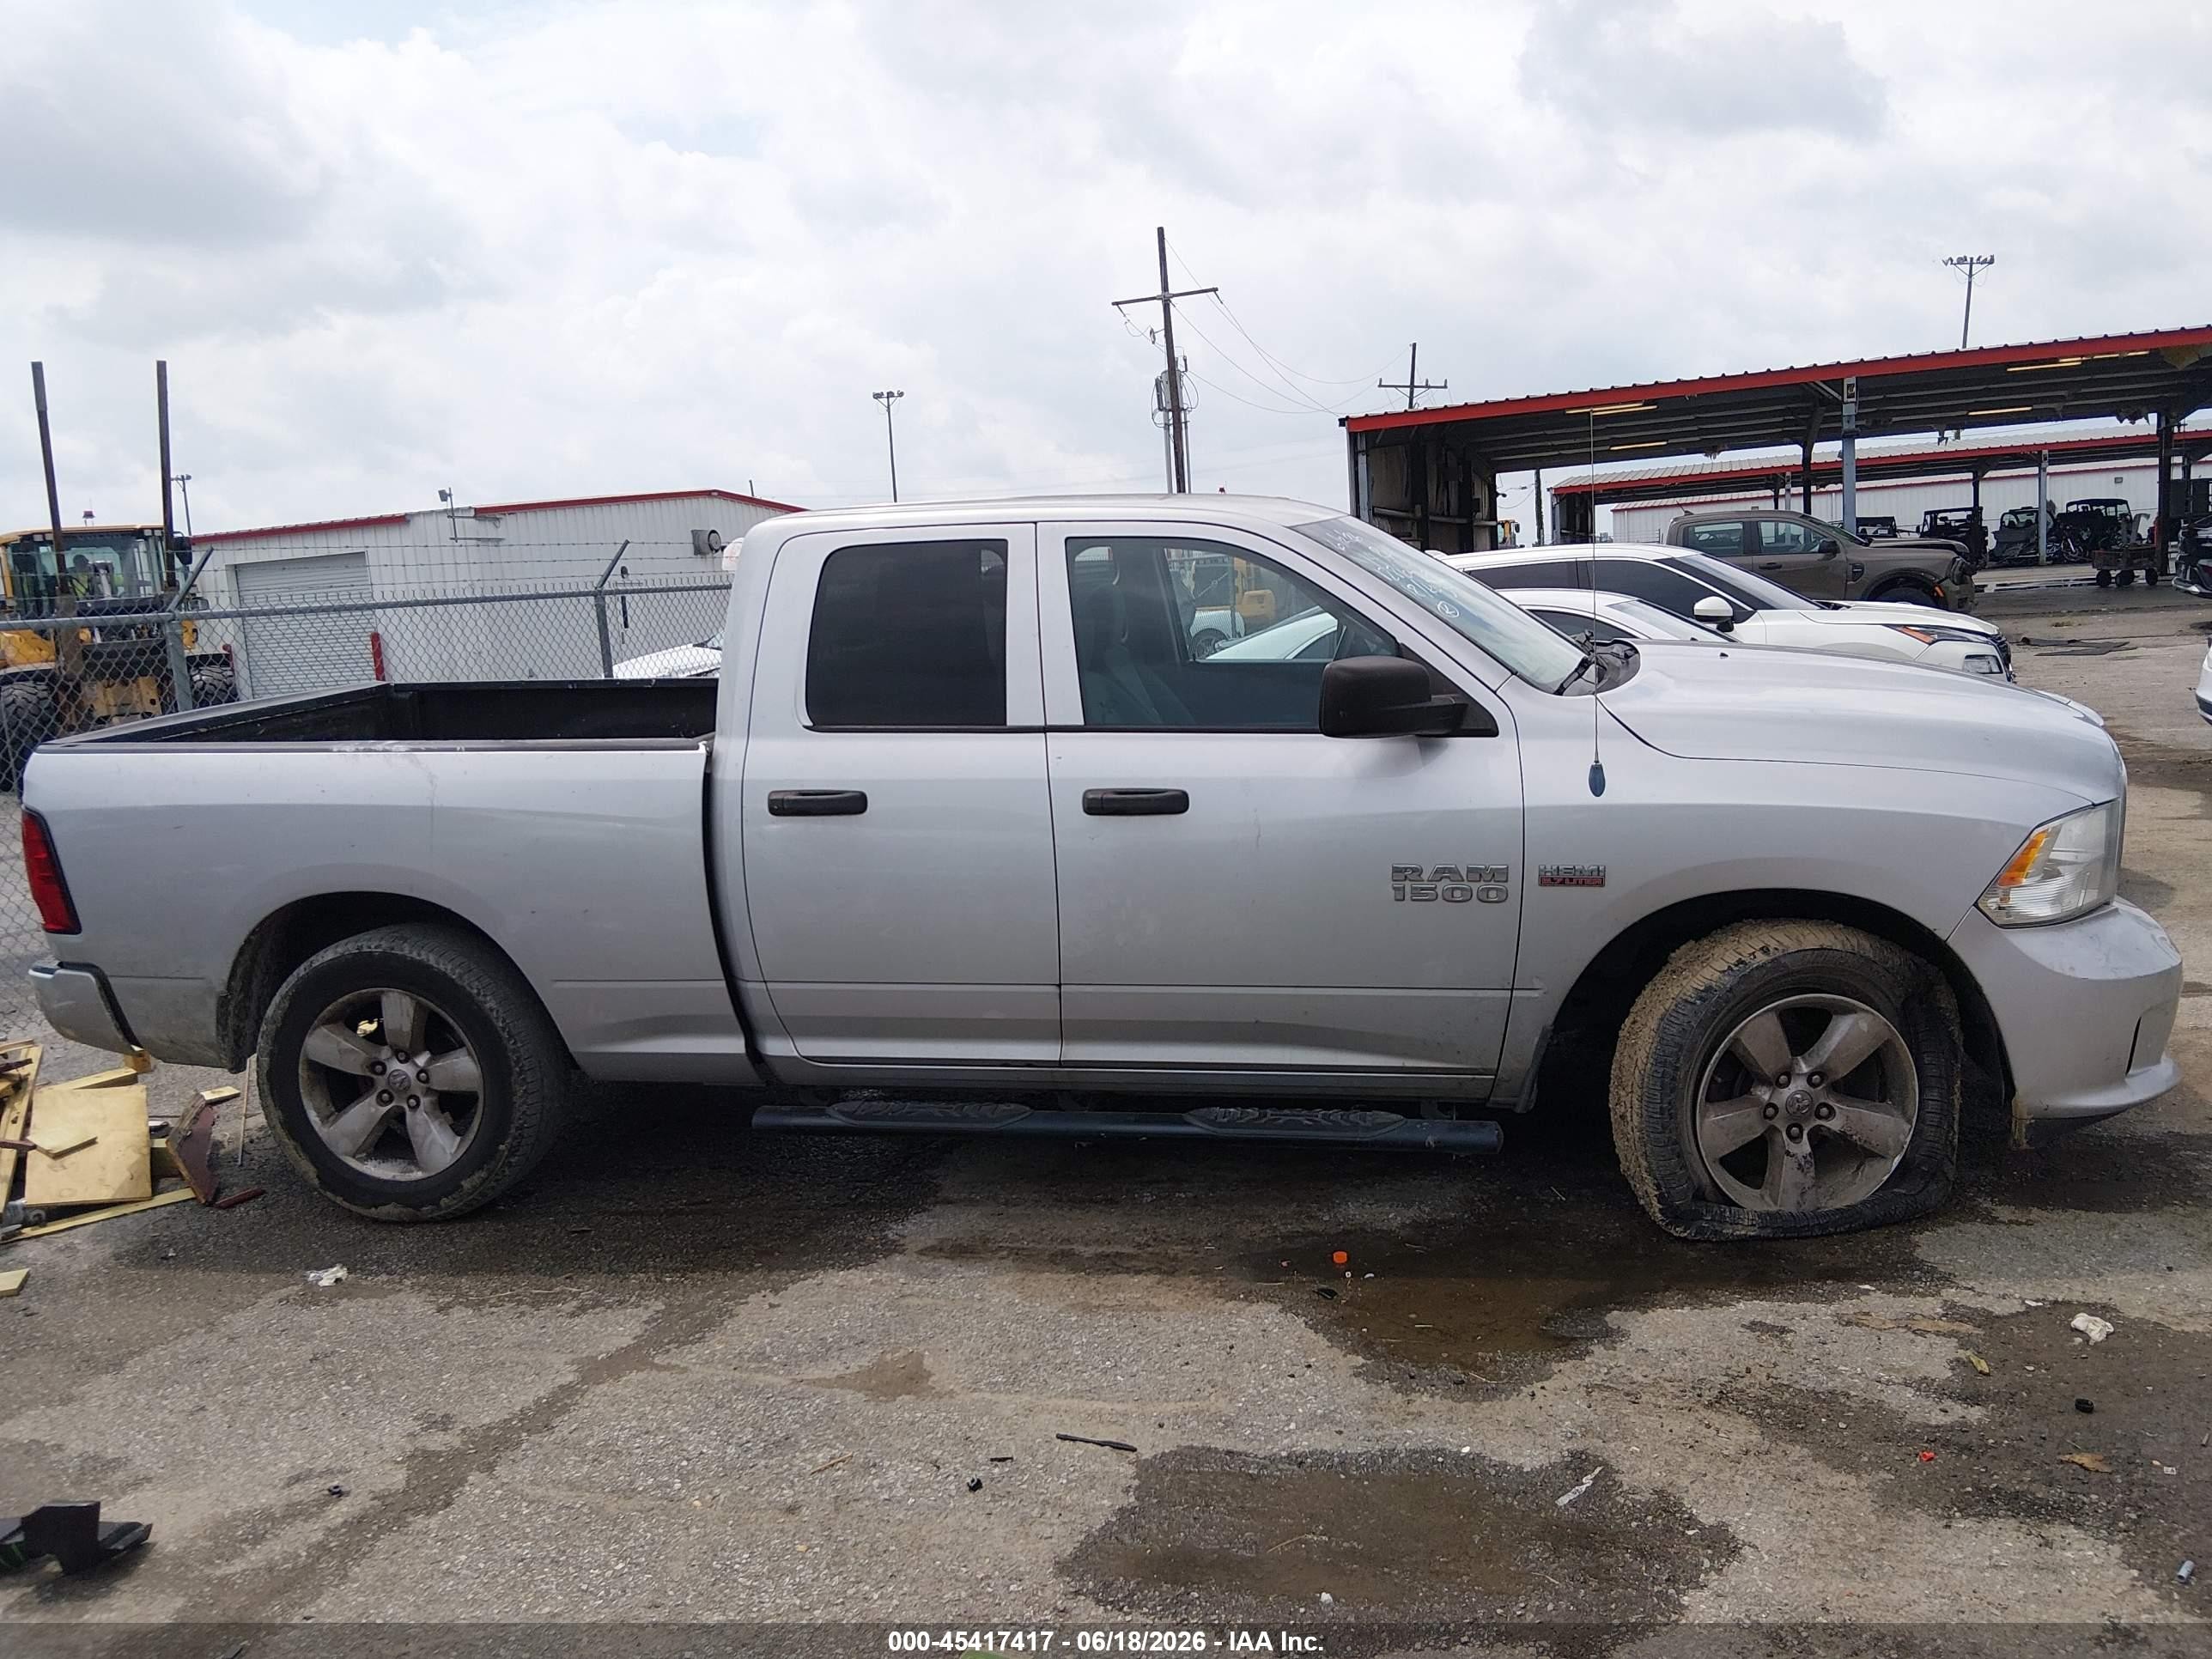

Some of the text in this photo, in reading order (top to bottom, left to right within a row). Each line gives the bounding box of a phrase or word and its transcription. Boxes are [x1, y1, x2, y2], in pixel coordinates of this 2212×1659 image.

[1391, 863, 1510, 883] RAM
[1539, 865, 1606, 877] HEMI
[1392, 884, 1509, 902] 1500
